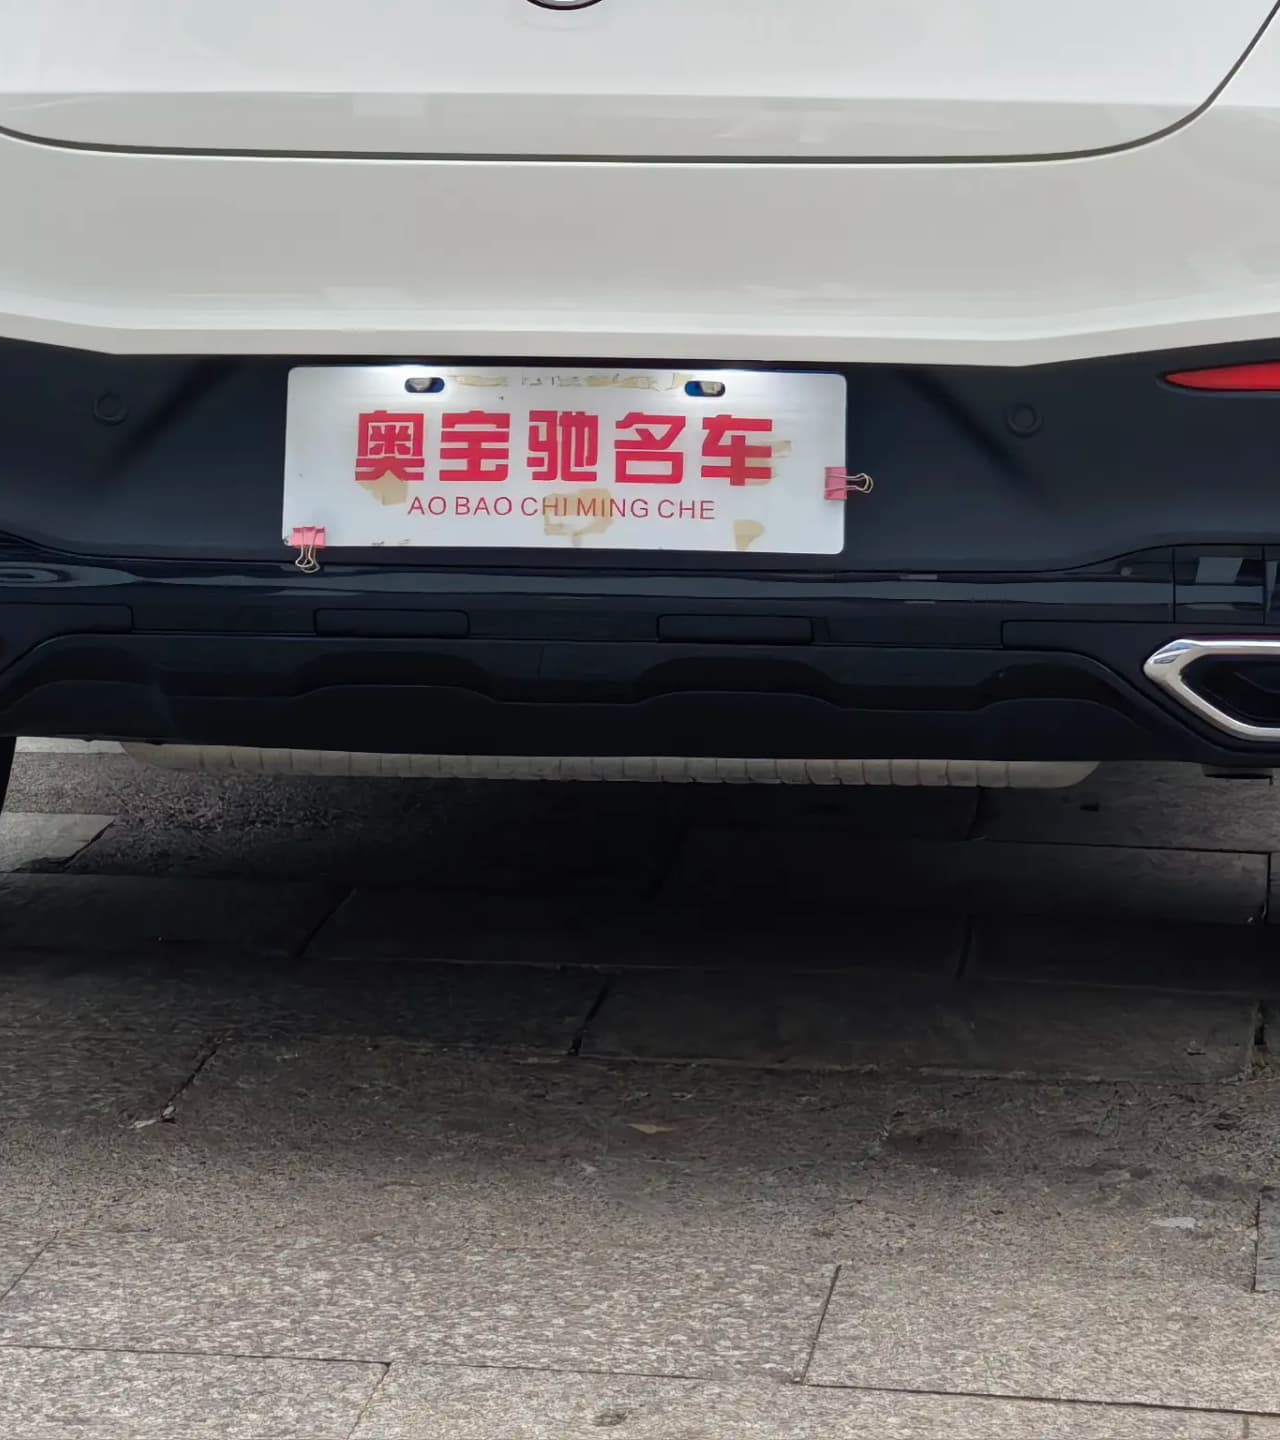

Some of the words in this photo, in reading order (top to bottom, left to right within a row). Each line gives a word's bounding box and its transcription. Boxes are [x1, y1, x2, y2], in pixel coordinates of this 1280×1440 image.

[355, 410, 773, 487] 奥宝驰名车
[407, 496, 447, 516] AO
[455, 496, 512, 517] BAO
[521, 497, 568, 518] CHI
[578, 497, 649, 520] MING
[657, 498, 716, 520] CHE
